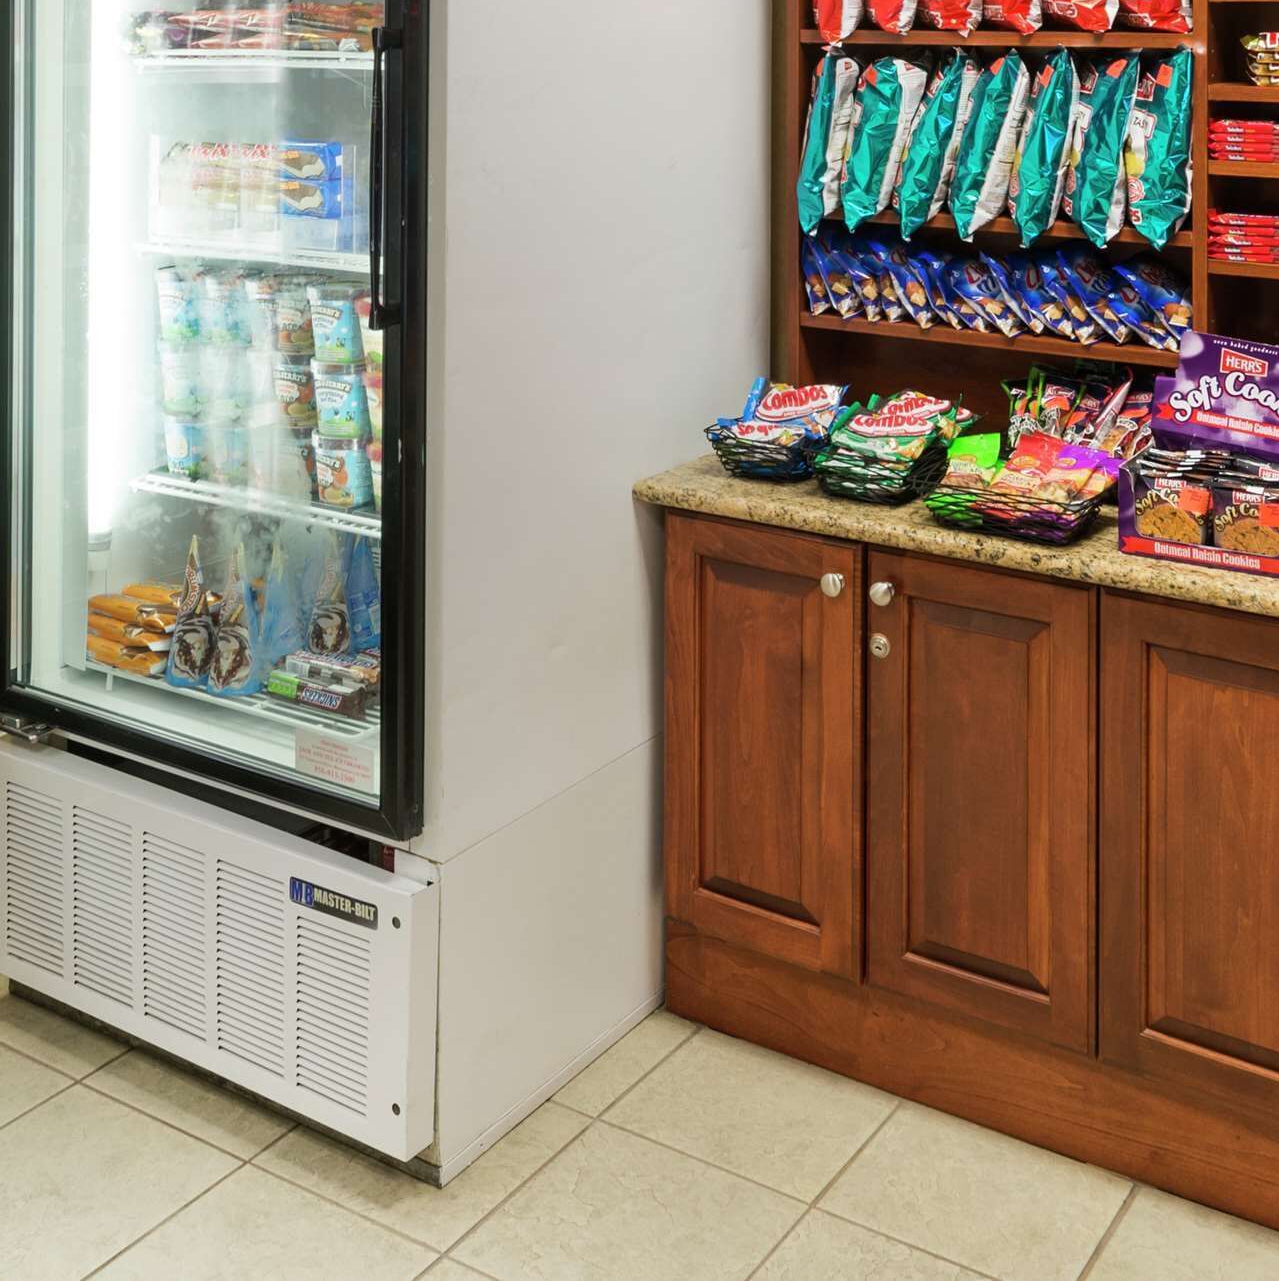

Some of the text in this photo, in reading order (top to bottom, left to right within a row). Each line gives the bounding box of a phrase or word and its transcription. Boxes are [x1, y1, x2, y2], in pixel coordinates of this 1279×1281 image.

[1225, 354, 1264, 374] HERR'S
[1169, 375, 1222, 422] Soft
[1196, 412, 1231, 427] Oatmeal
[1233, 418, 1253, 431] Raisin
[1136, 490, 1166, 515] Soft
[1215, 507, 1242, 532] Soft
[1154, 543, 1260, 570] Oatmeal Raisin Cookies
[314, 888, 376, 921] MASTER-BILT
